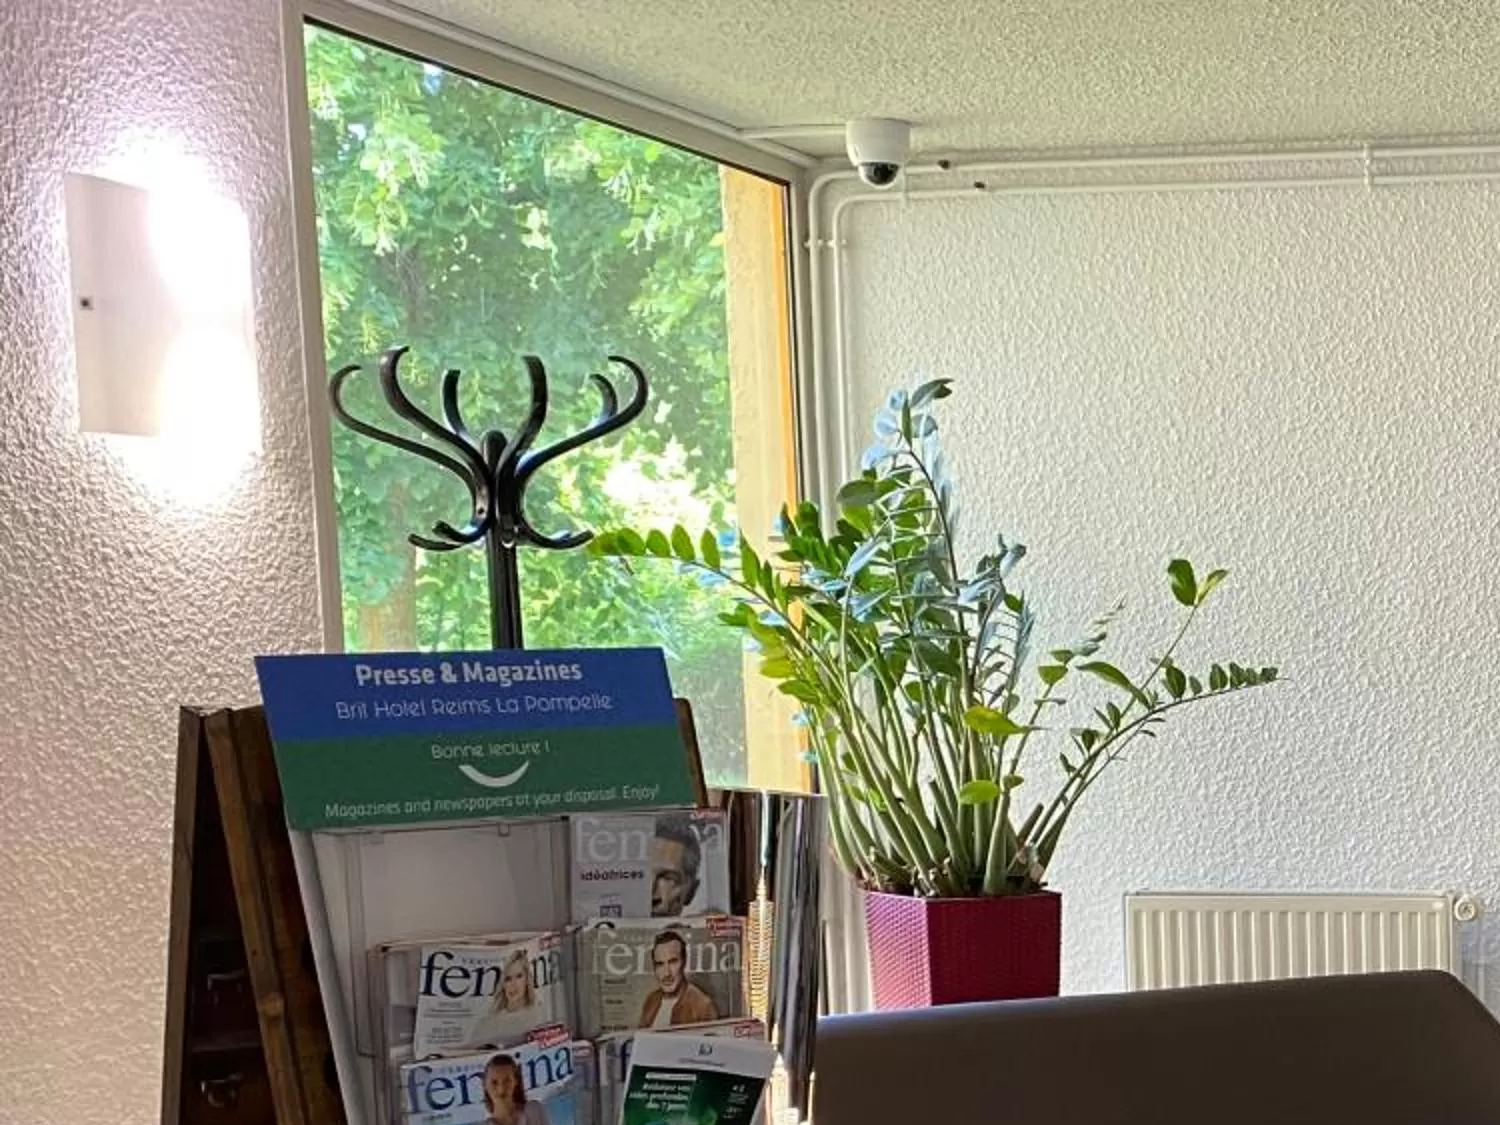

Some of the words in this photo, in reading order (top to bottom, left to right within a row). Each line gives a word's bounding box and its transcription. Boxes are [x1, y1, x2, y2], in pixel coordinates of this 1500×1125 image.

[355, 664, 435, 686] Presse
[440, 661, 458, 683] &
[462, 659, 582, 687] Magazines
[431, 697, 492, 715] Reims
[496, 697, 519, 713] La
[524, 693, 614, 713] Pompelle
[431, 743, 484, 759] Bonne
[325, 802, 400, 820] Magazines
[405, 799, 431, 813] and
[434, 794, 513, 812] newspapers
[515, 793, 530, 806] at
[533, 792, 561, 807] your
[622, 783, 660, 802] Enjoy!
[420, 950, 563, 998] femna
[408, 1045, 574, 1114] fena
